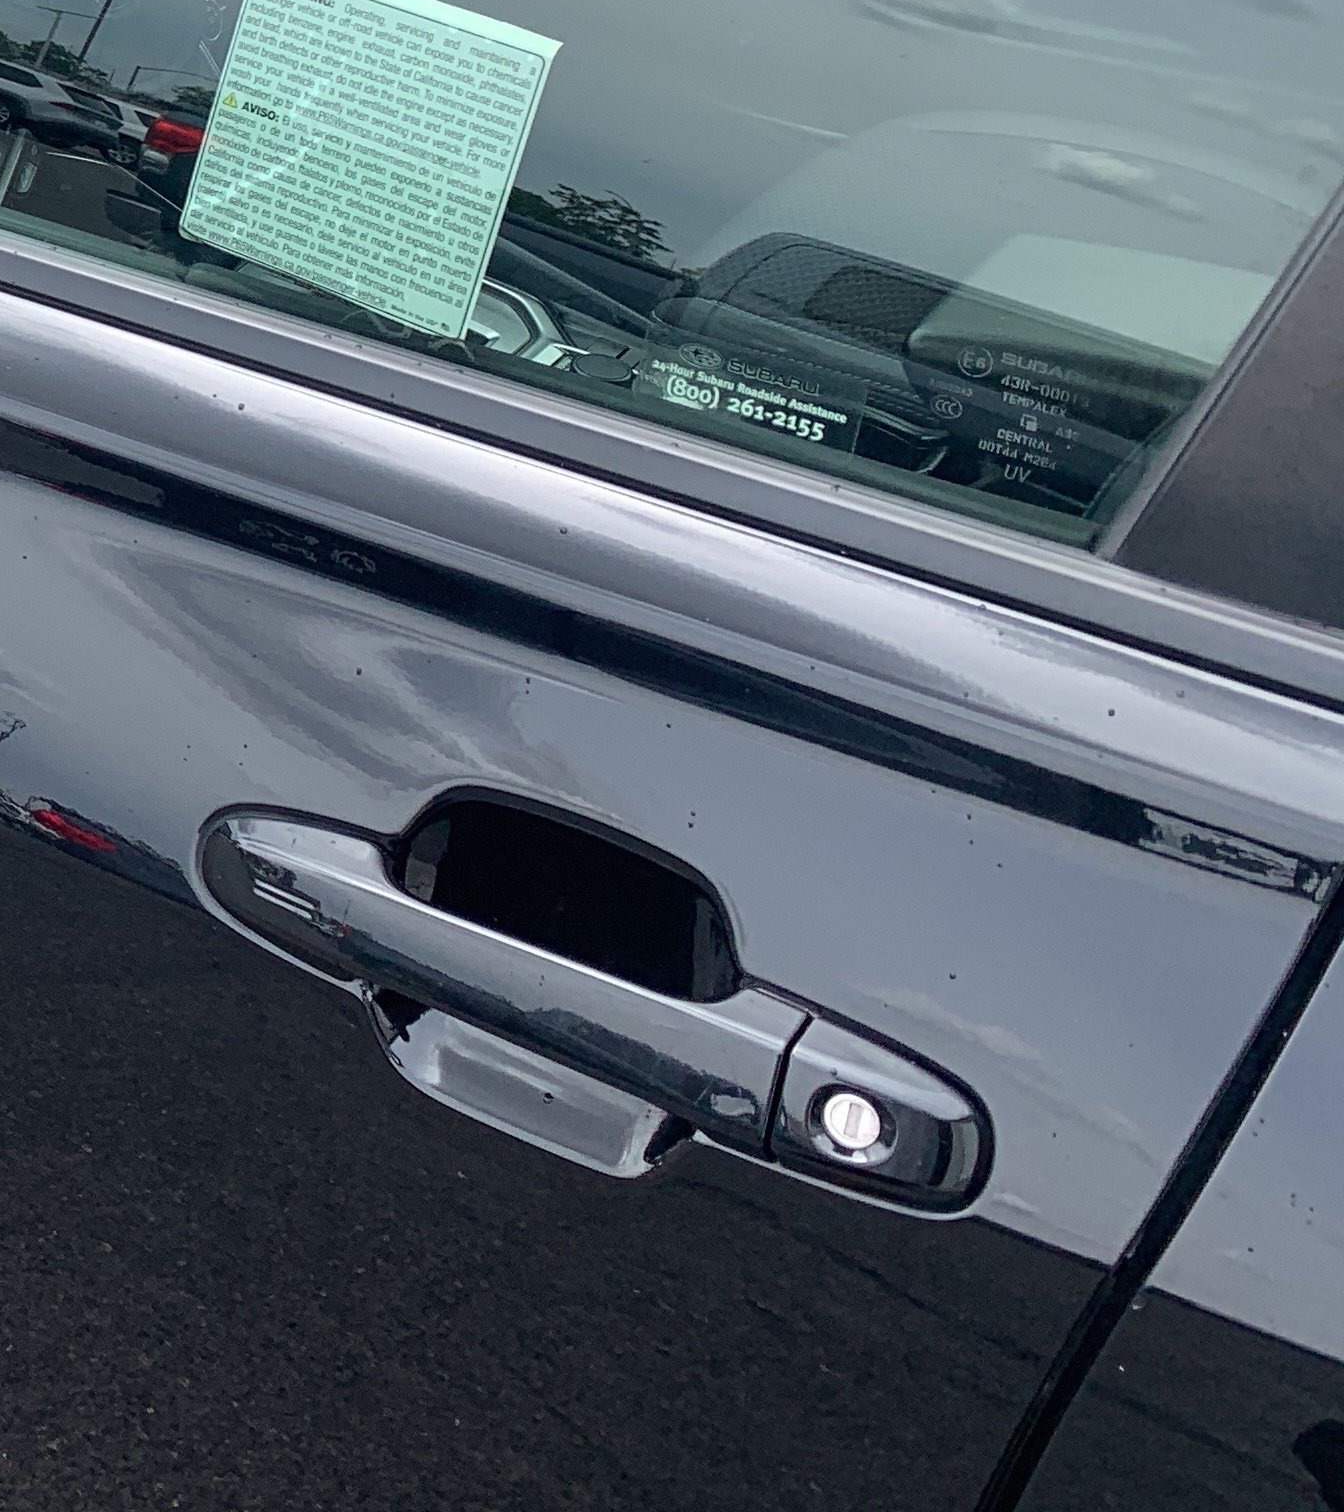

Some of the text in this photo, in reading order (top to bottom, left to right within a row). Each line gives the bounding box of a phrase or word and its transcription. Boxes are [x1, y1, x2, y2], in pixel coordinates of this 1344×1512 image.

[241, 101, 279, 122] AVISO:
[727, 357, 820, 397] SUBARU
[651, 358, 848, 425] 24-Hour Subaru Roadside Assistance
[1002, 391, 1067, 417] TEMPALEX
[665, 374, 826, 442] (800) 261-2155
[996, 427, 1054, 453] CENTRAL
[1004, 463, 1033, 484] UV
